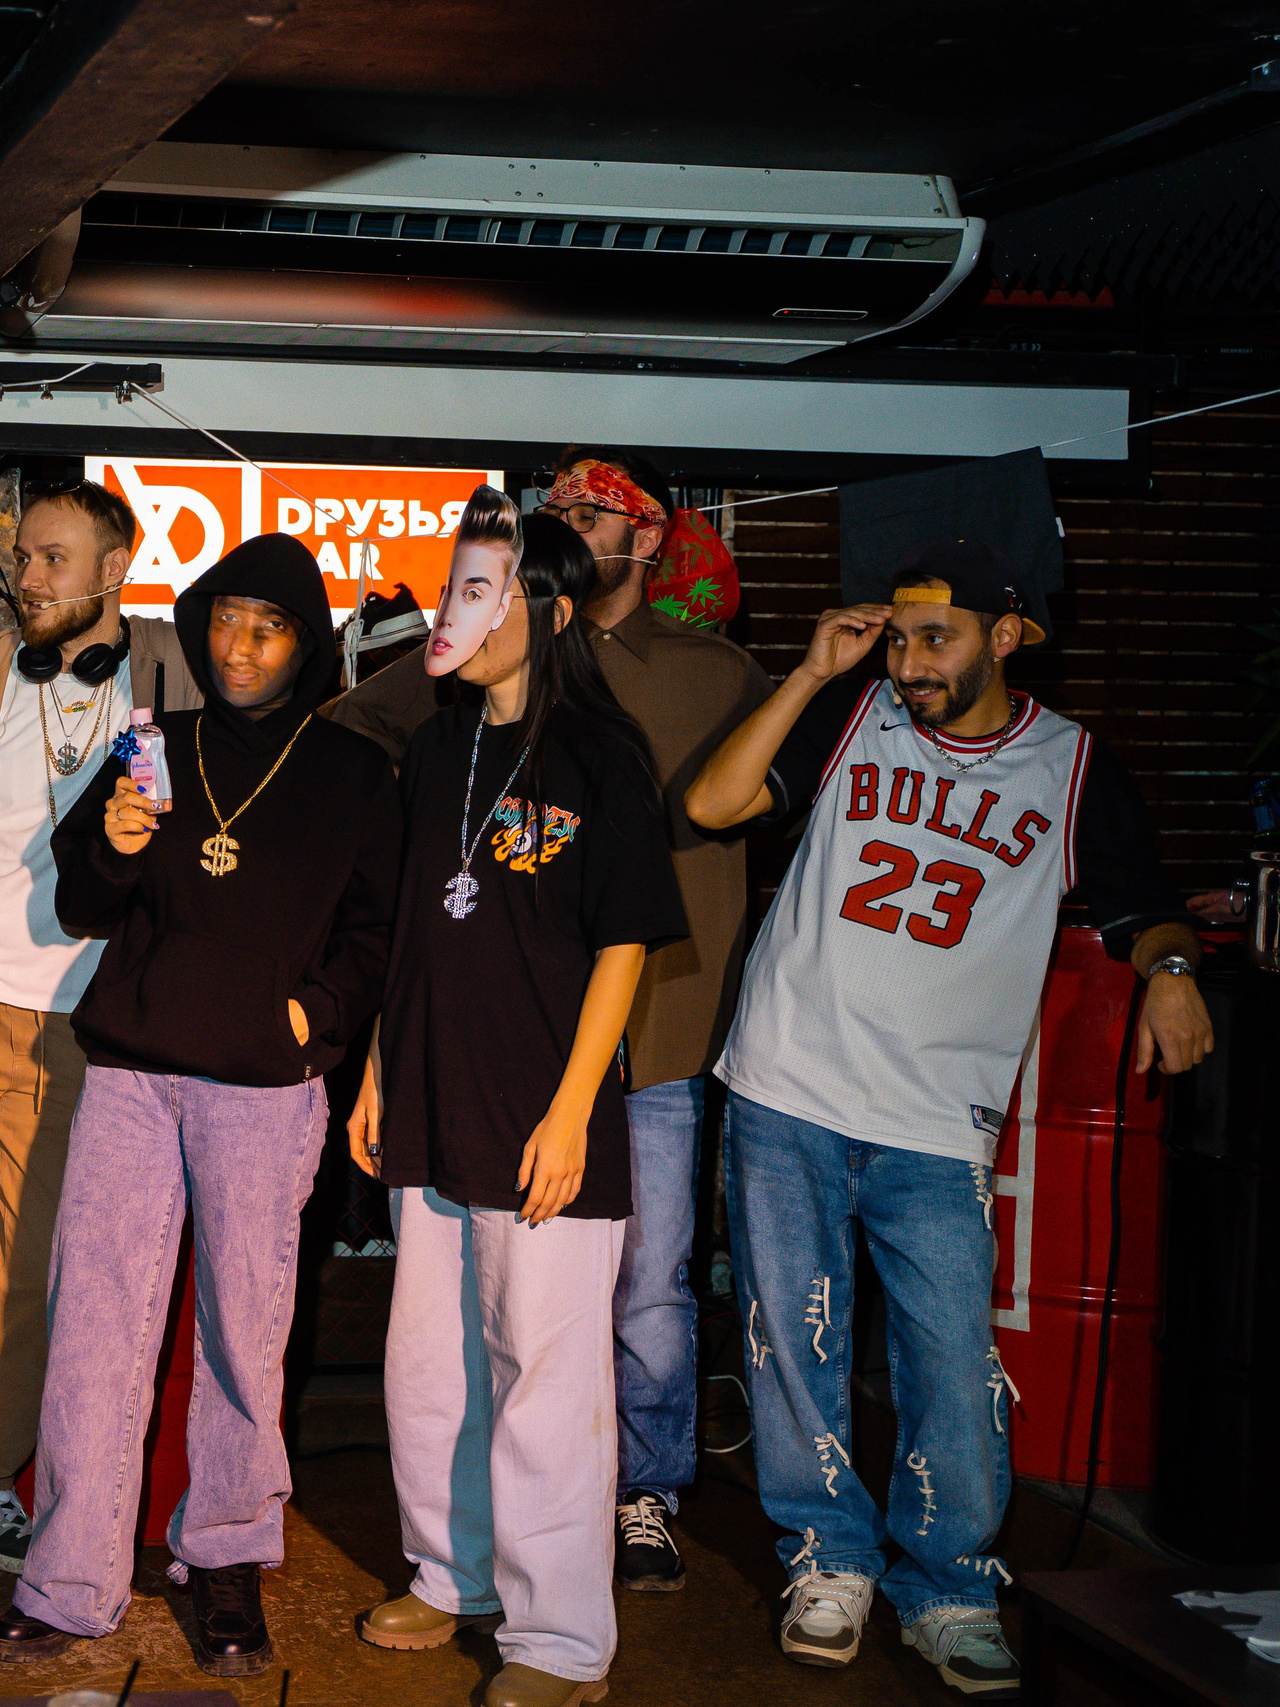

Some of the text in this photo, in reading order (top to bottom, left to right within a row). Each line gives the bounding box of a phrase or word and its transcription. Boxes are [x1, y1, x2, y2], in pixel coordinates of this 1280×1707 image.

[316, 541, 384, 581] AR
[846, 762, 1052, 868] BULLS
[200, 834, 240, 876] $
[839, 839, 986, 949] 23
